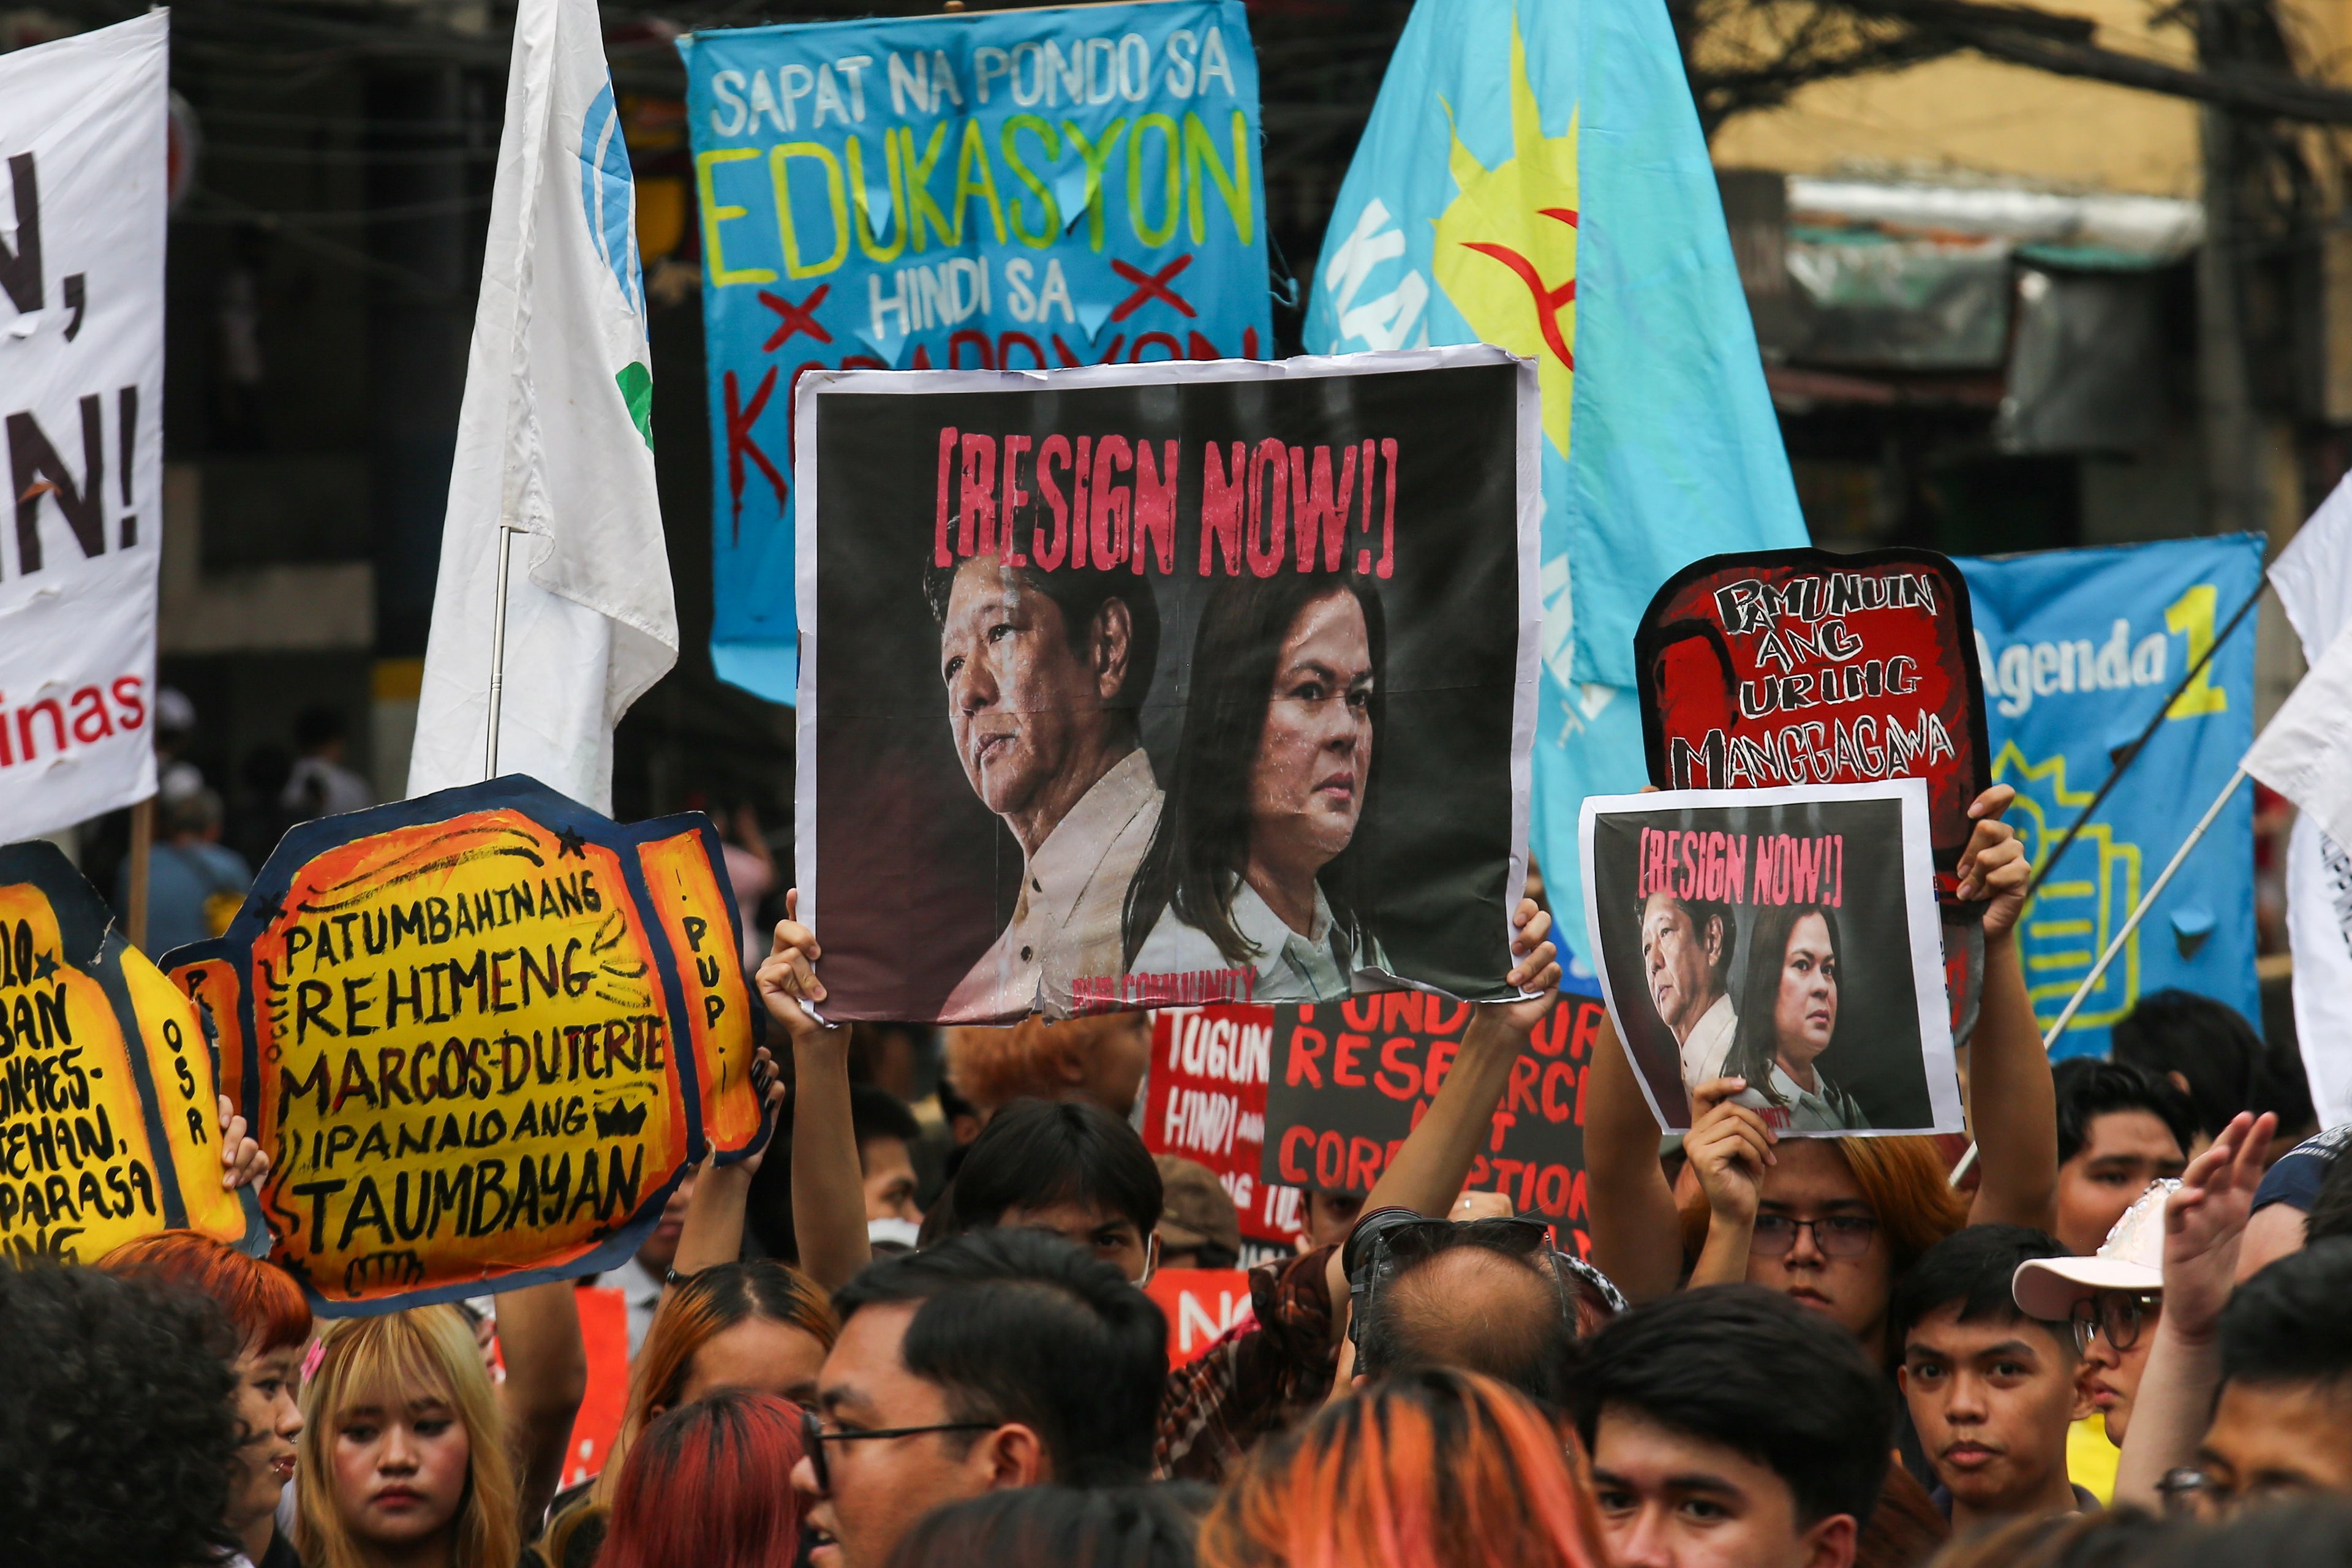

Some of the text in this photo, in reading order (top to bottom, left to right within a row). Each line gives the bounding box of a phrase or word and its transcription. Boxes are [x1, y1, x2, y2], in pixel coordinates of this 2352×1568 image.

[710, 26, 1235, 137] SAPAT NA PONDO SA
[697, 110, 1254, 288] EDUKASYON
[868, 255, 1076, 341] HINDI SA
[1740, 655, 1923, 720] URING
[1755, 619, 1864, 674] ANG
[2164, 584, 2228, 720] 1
[1670, 707, 1956, 790] MANGGAGAWA
[296, 937, 597, 1044] REHIMENG
[1164, 1085, 1238, 1156] HINDI
[292, 1143, 645, 1254] TAUMBAYAN
